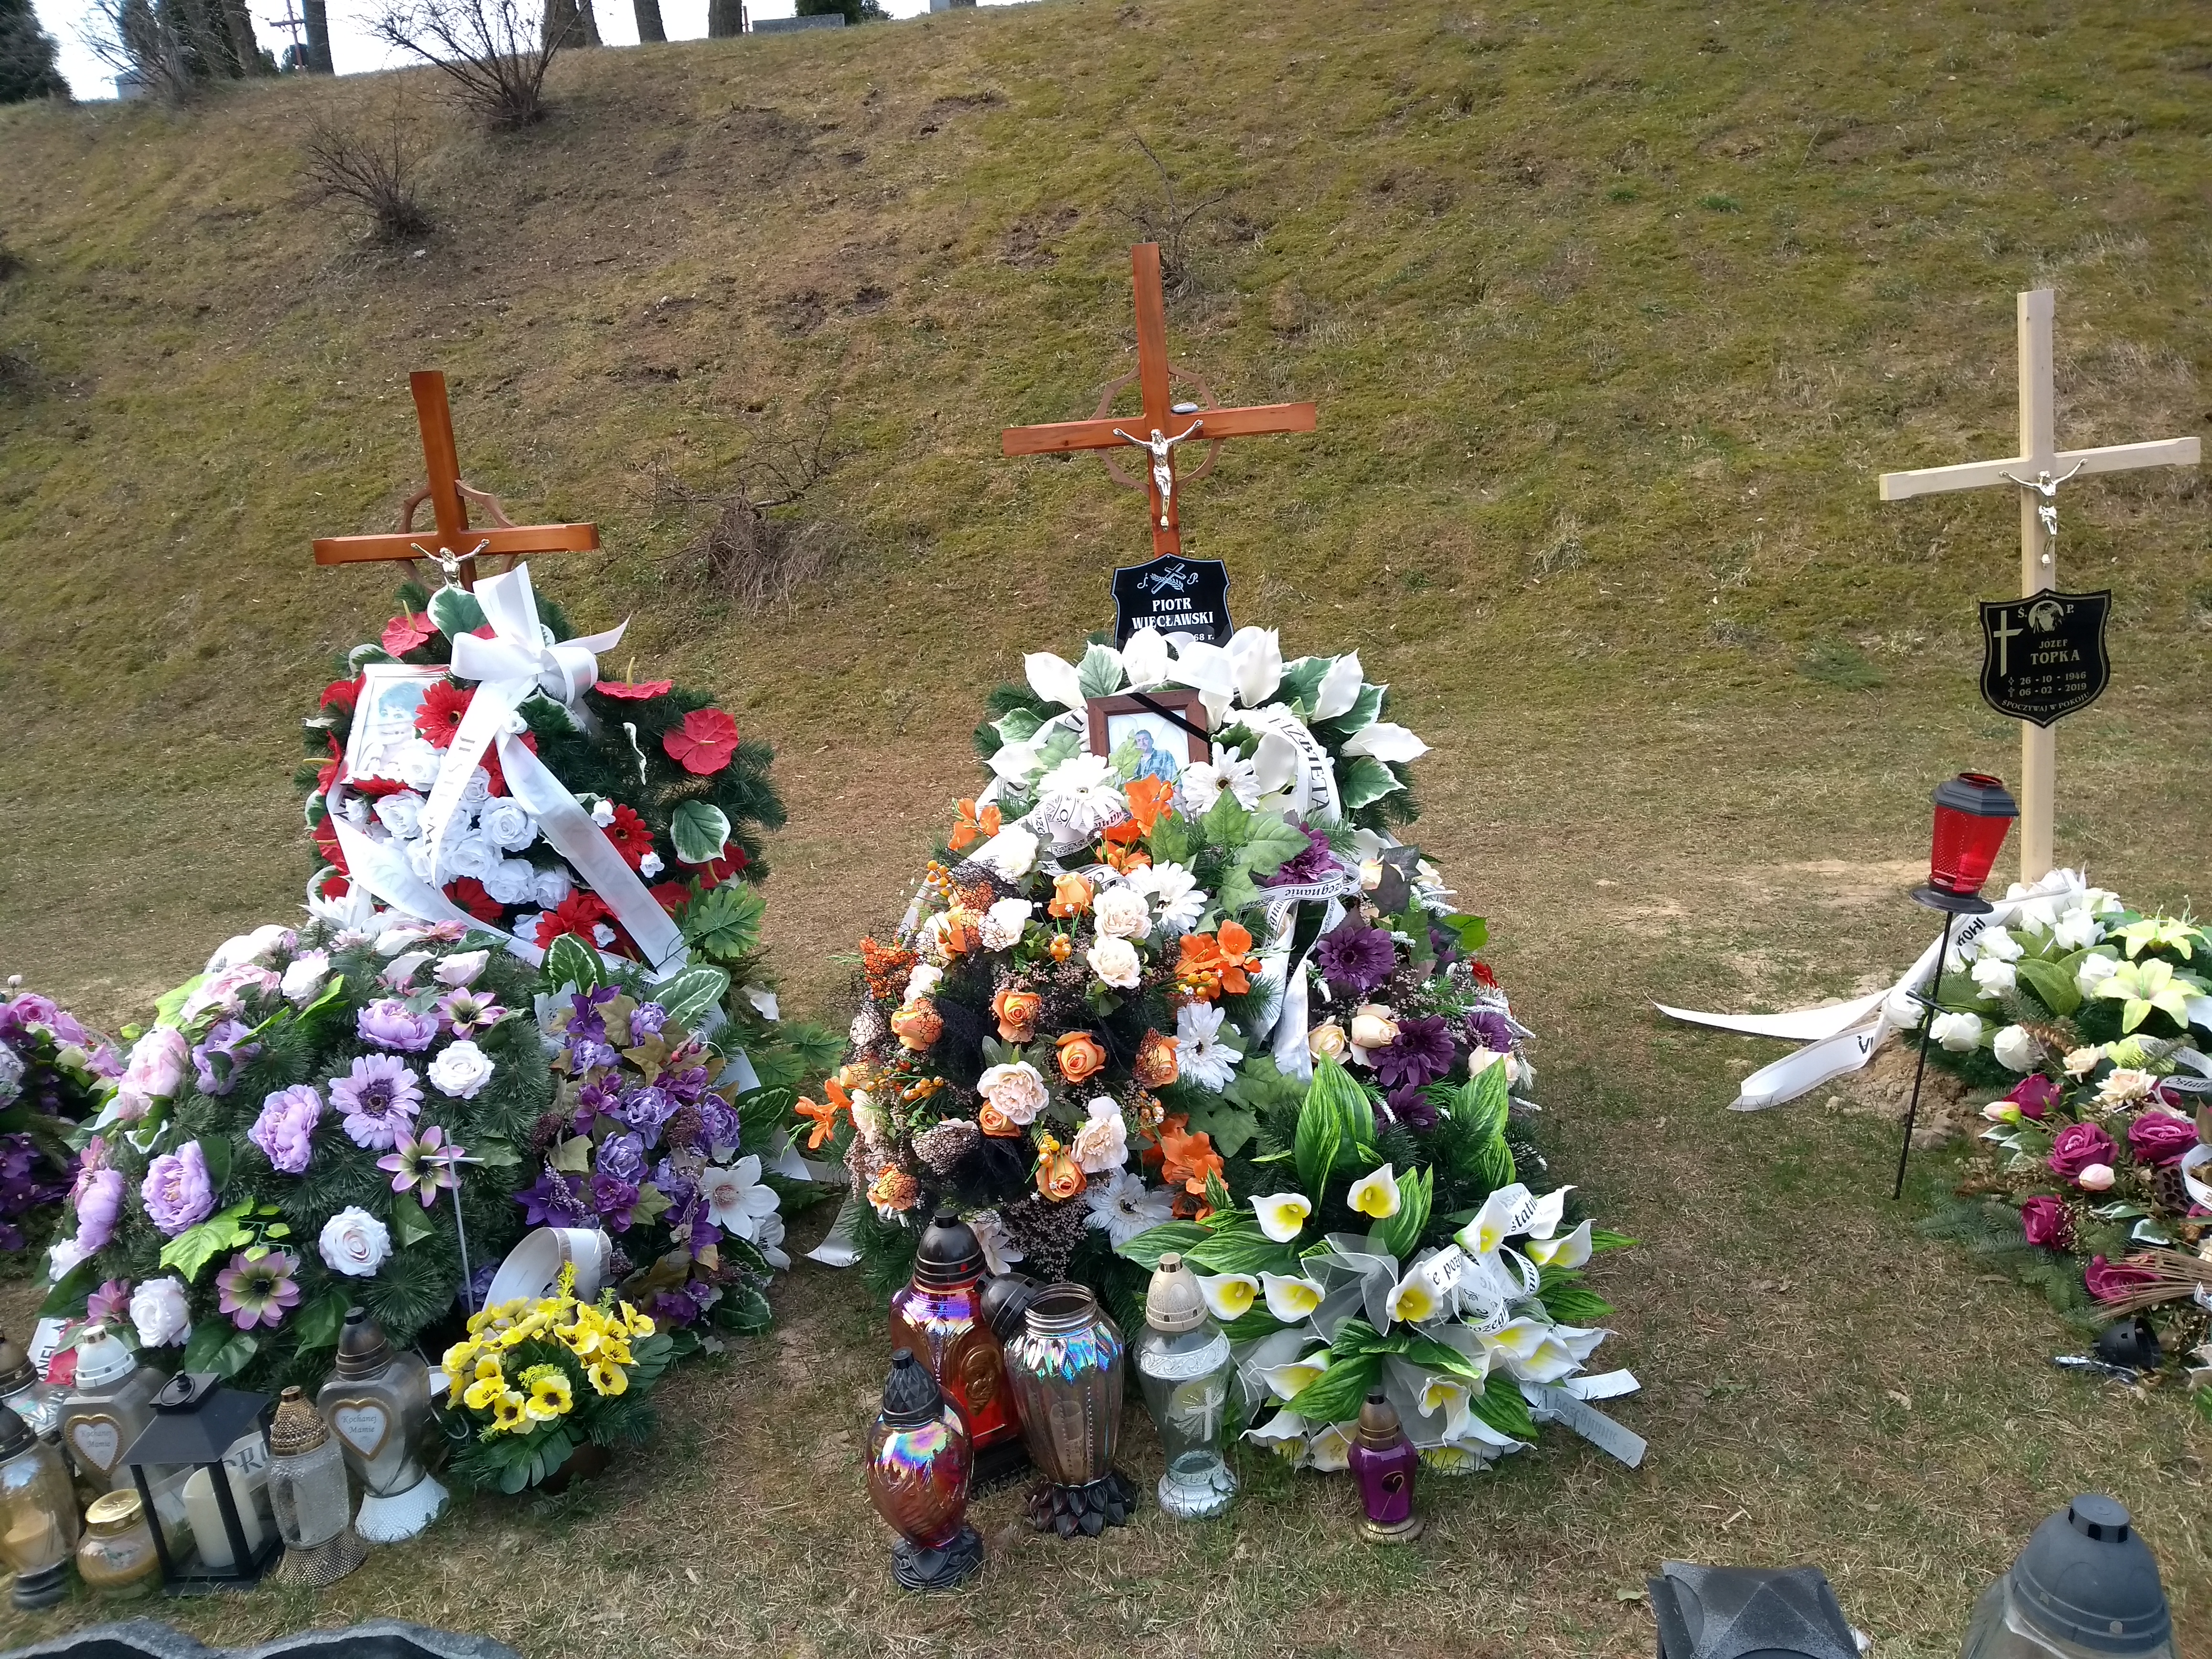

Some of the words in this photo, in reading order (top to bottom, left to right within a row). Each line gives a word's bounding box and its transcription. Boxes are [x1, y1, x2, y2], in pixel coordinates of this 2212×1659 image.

[1152, 597, 1192, 612] PIOTR
[1131, 611, 1213, 629] WIĘCŁAWSKI
[2039, 638, 2068, 649] JÓZEF
[2031, 649, 2080, 665] TOPKA
[2020, 677, 2031, 685] 26
[2042, 675, 2052, 683] 10
[2065, 671, 2086, 681] 1946
[2019, 688, 2031, 696] 06
[2041, 685, 2052, 694] 02
[2065, 682, 2087, 692] 2019
[2001, 699, 2047, 712] SPOCZYWAJ
[2058, 691, 2090, 709] POKOJU
[341, 1414, 377, 1424] Kochanej
